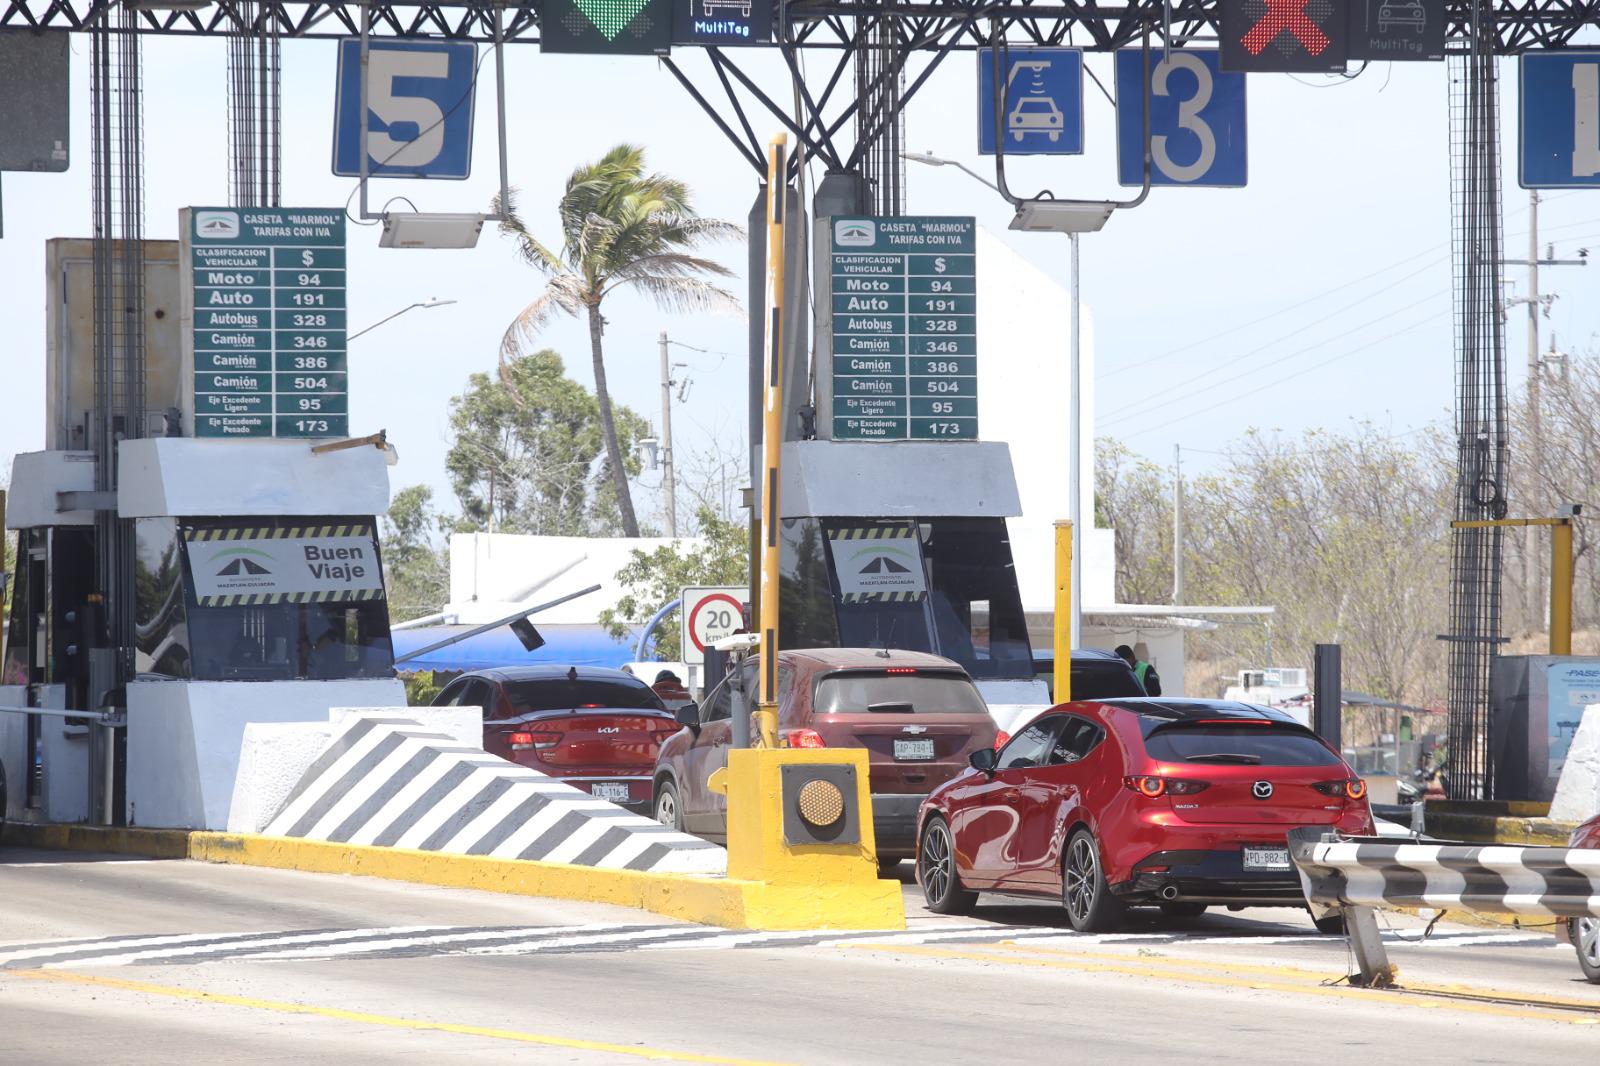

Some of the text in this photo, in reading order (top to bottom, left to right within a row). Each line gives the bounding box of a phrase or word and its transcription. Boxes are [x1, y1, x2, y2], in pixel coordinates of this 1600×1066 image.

[695, 21, 750, 37] MultiTag
[1369, 38, 1424, 53] MultiTag
[366, 49, 449, 167] 5
[1151, 52, 1216, 182] 3
[244, 215, 282, 224] CASETA
[254, 227, 330, 236] TARIFAS CON IVA
[880, 223, 916, 232] CASETA
[890, 235, 962, 244] TARIFAS CON IVA
[302, 249, 314, 267] $
[935, 257, 946, 273] $
[208, 273, 254, 284] Moto
[298, 274, 320, 285] 94
[846, 280, 889, 290] Moto
[931, 281, 952, 292] 94
[210, 291, 253, 304] Auto
[293, 294, 324, 305] 191
[848, 298, 888, 310] Auto
[926, 301, 955, 311] 191
[210, 313, 258, 324] Autobus
[294, 315, 326, 326] 328
[848, 319, 892, 330] Autobus
[926, 321, 957, 331] 328
[212, 333, 255, 344] Camión
[294, 336, 327, 347] 346
[850, 339, 890, 349] Camión
[927, 342, 958, 352] 346
[213, 355, 256, 365] Camión
[295, 357, 327, 368] 386
[851, 360, 891, 370] Camión
[928, 362, 958, 373] 386
[214, 376, 257, 387] Camión
[294, 378, 327, 389] 504
[852, 380, 892, 390] Camión
[928, 382, 959, 392] 504
[208, 396, 221, 404] Eje
[299, 399, 321, 410] 95
[932, 403, 953, 413] 95
[209, 418, 221, 426] Eje
[296, 421, 328, 432] 173
[929, 424, 959, 434] 173
[304, 545, 363, 561] Buen
[308, 563, 365, 582] Viaje
[706, 610, 731, 629] 20
